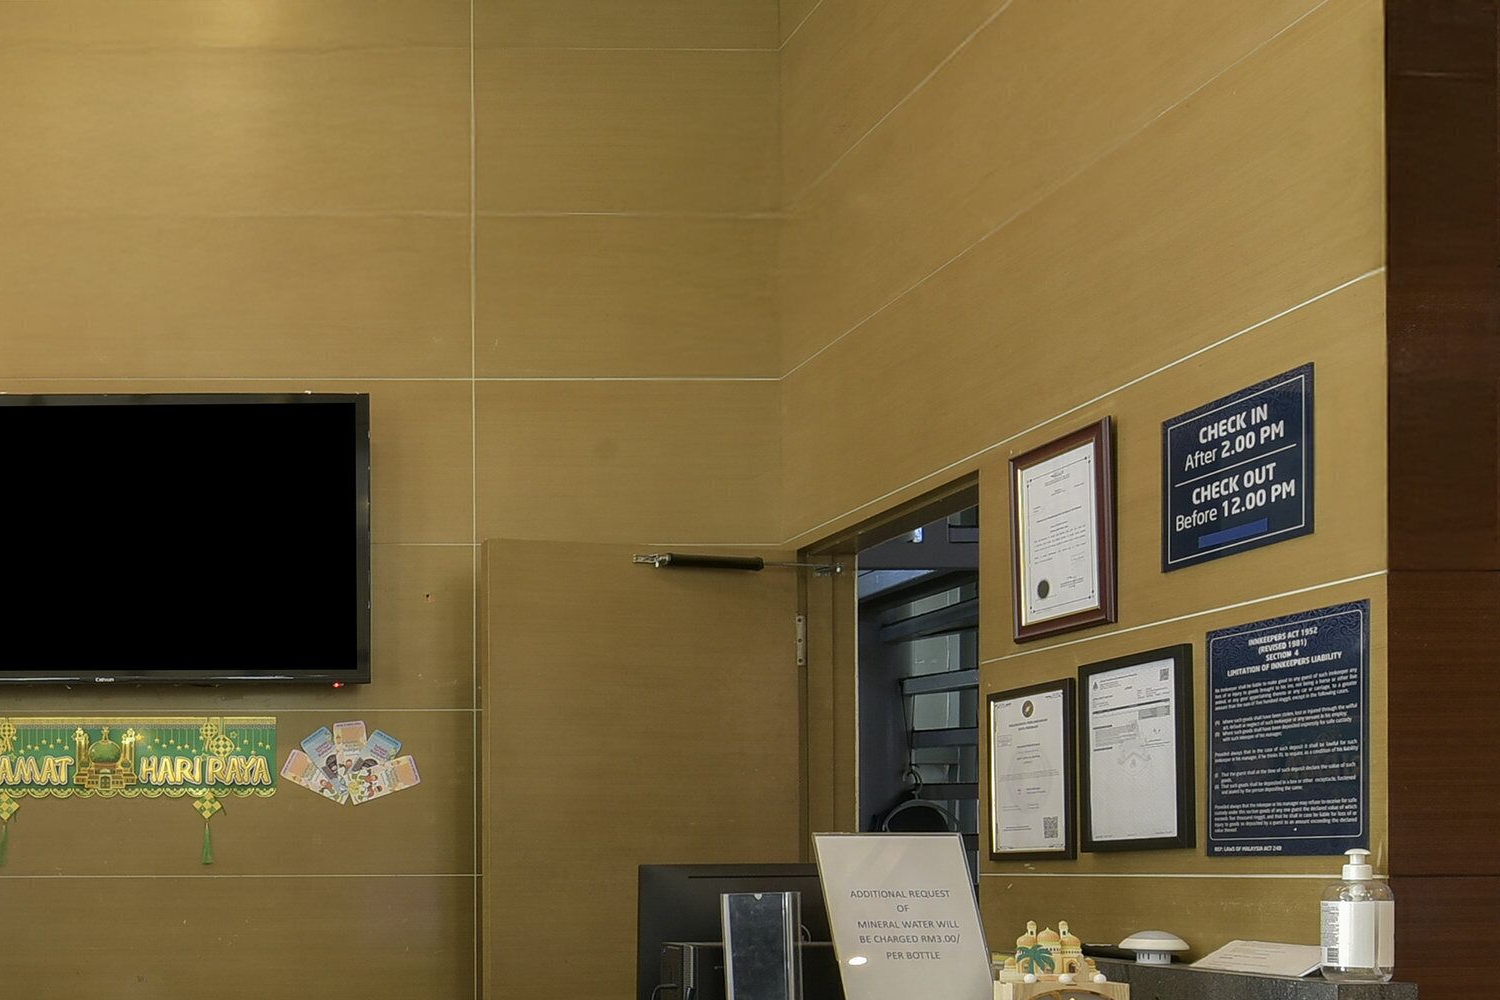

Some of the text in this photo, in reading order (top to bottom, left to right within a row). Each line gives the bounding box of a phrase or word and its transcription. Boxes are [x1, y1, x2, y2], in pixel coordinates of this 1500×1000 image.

[1199, 404, 1268, 444] CHECK IN
[1185, 420, 1284, 471] After 2.00 PM
[1192, 462, 1276, 505] CHECK OUT
[1176, 479, 1295, 532] Before 12.00 PM
[1248, 627, 1318, 646] INNKEEPERS ACT 1952
[1258, 642, 1286, 655] (REVISED
[1227, 651, 1342, 677] LIMITATION OF INNKEEPERS LIABILITY
[1266, 651, 1292, 662] SECTION
[139, 755, 200, 785] HARI
[206, 755, 272, 785] RAYA
[850, 890, 950, 898] ADDITIONAL REQUEST
[860, 935, 961, 943] BE CHARGED RM3.00/
